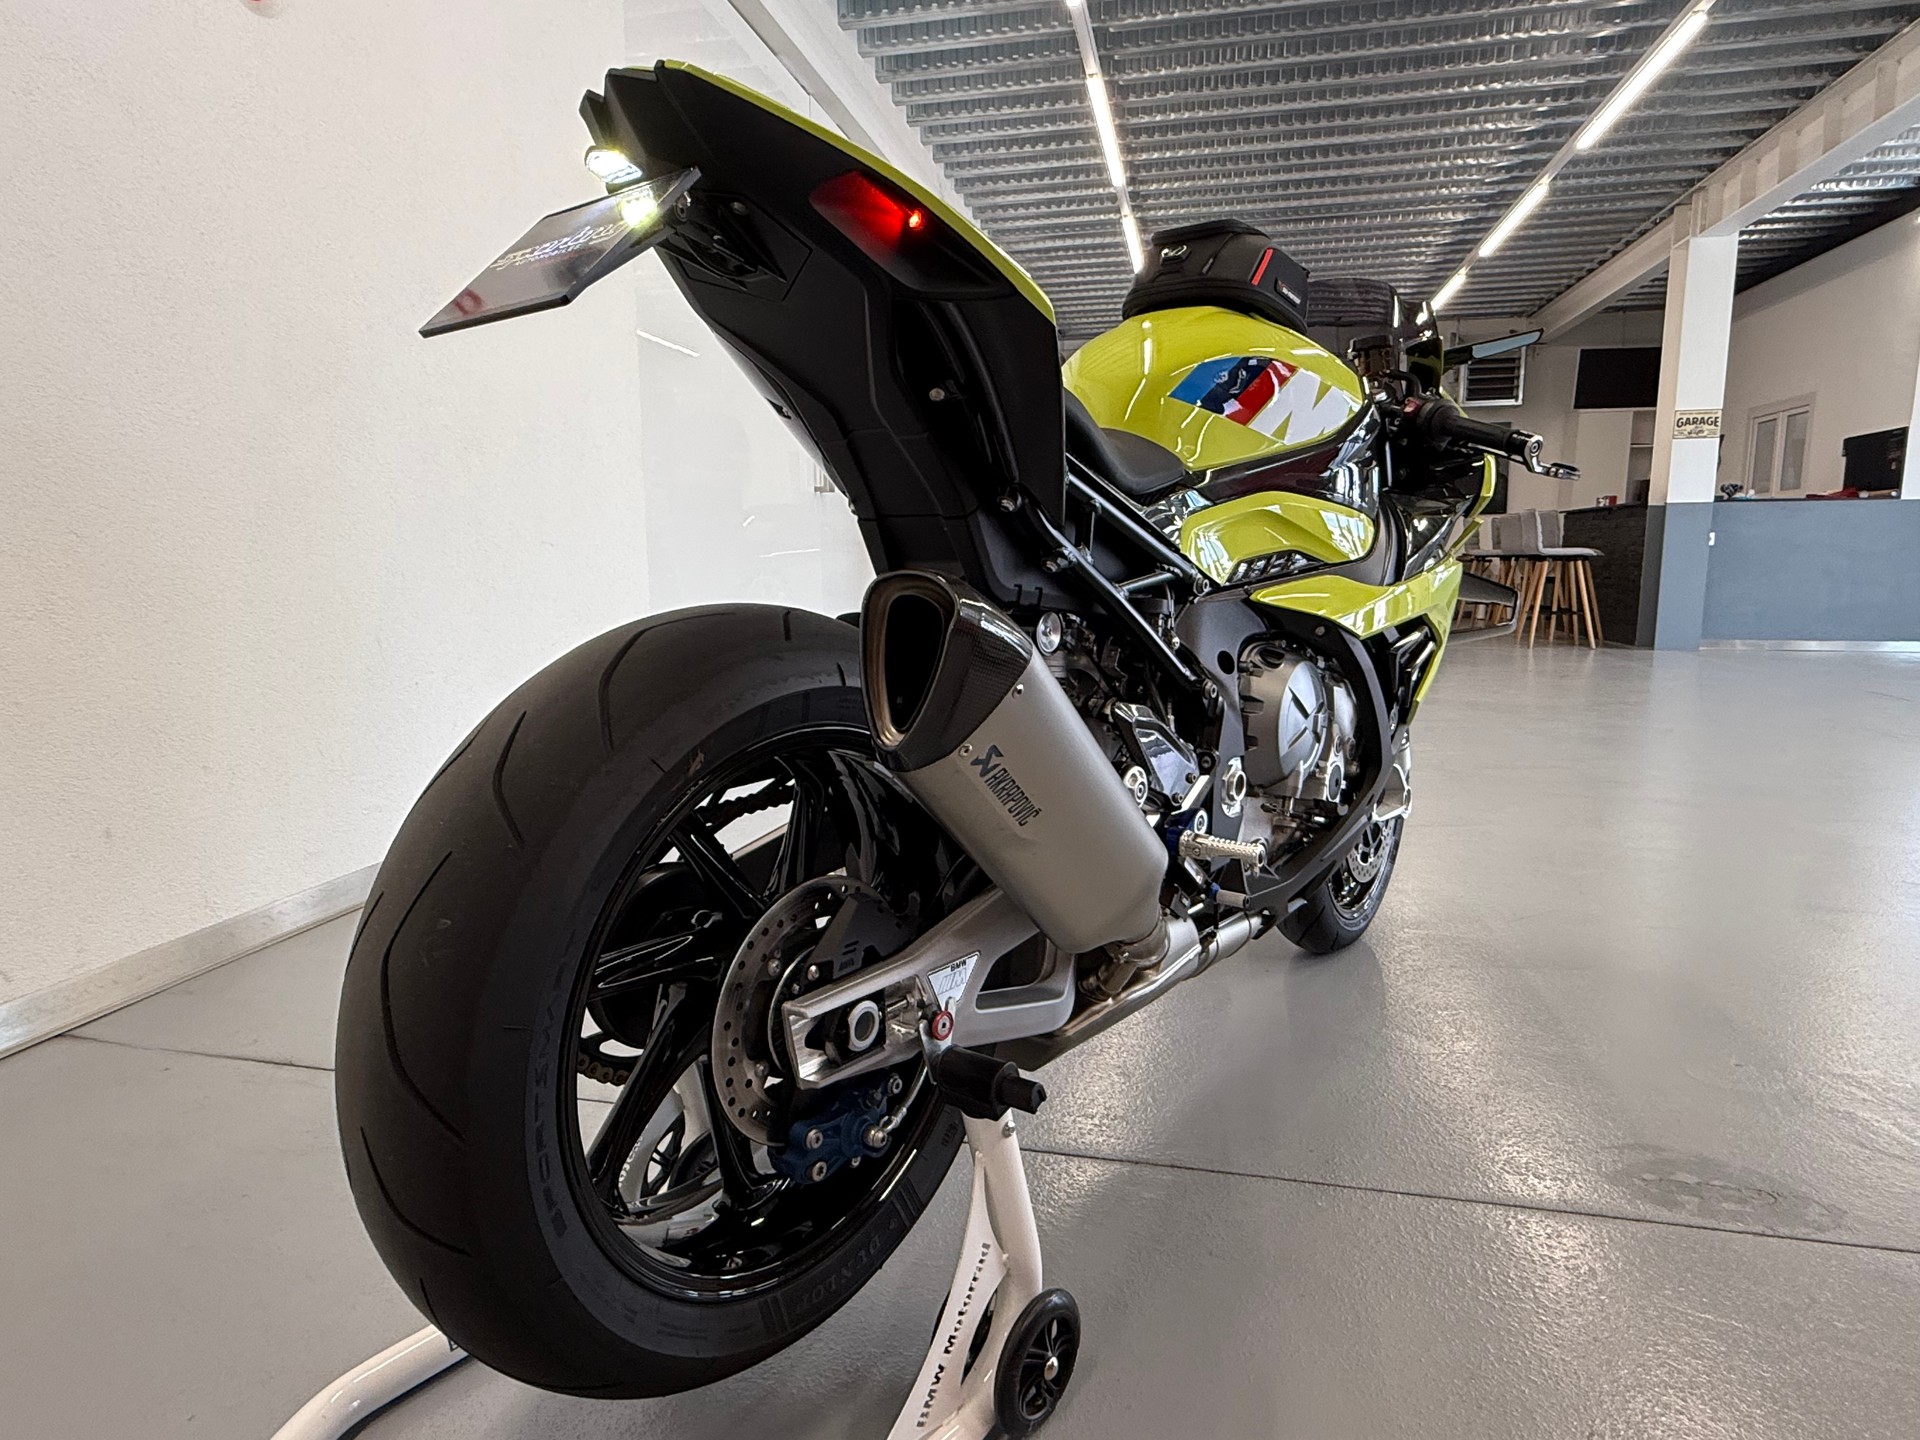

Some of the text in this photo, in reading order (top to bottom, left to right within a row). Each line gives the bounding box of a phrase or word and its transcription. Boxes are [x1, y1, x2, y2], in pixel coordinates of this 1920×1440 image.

[1676, 416, 1720, 428] GARAGE
[950, 959, 967, 972] BMW
[916, 1363, 945, 1428] BMW
